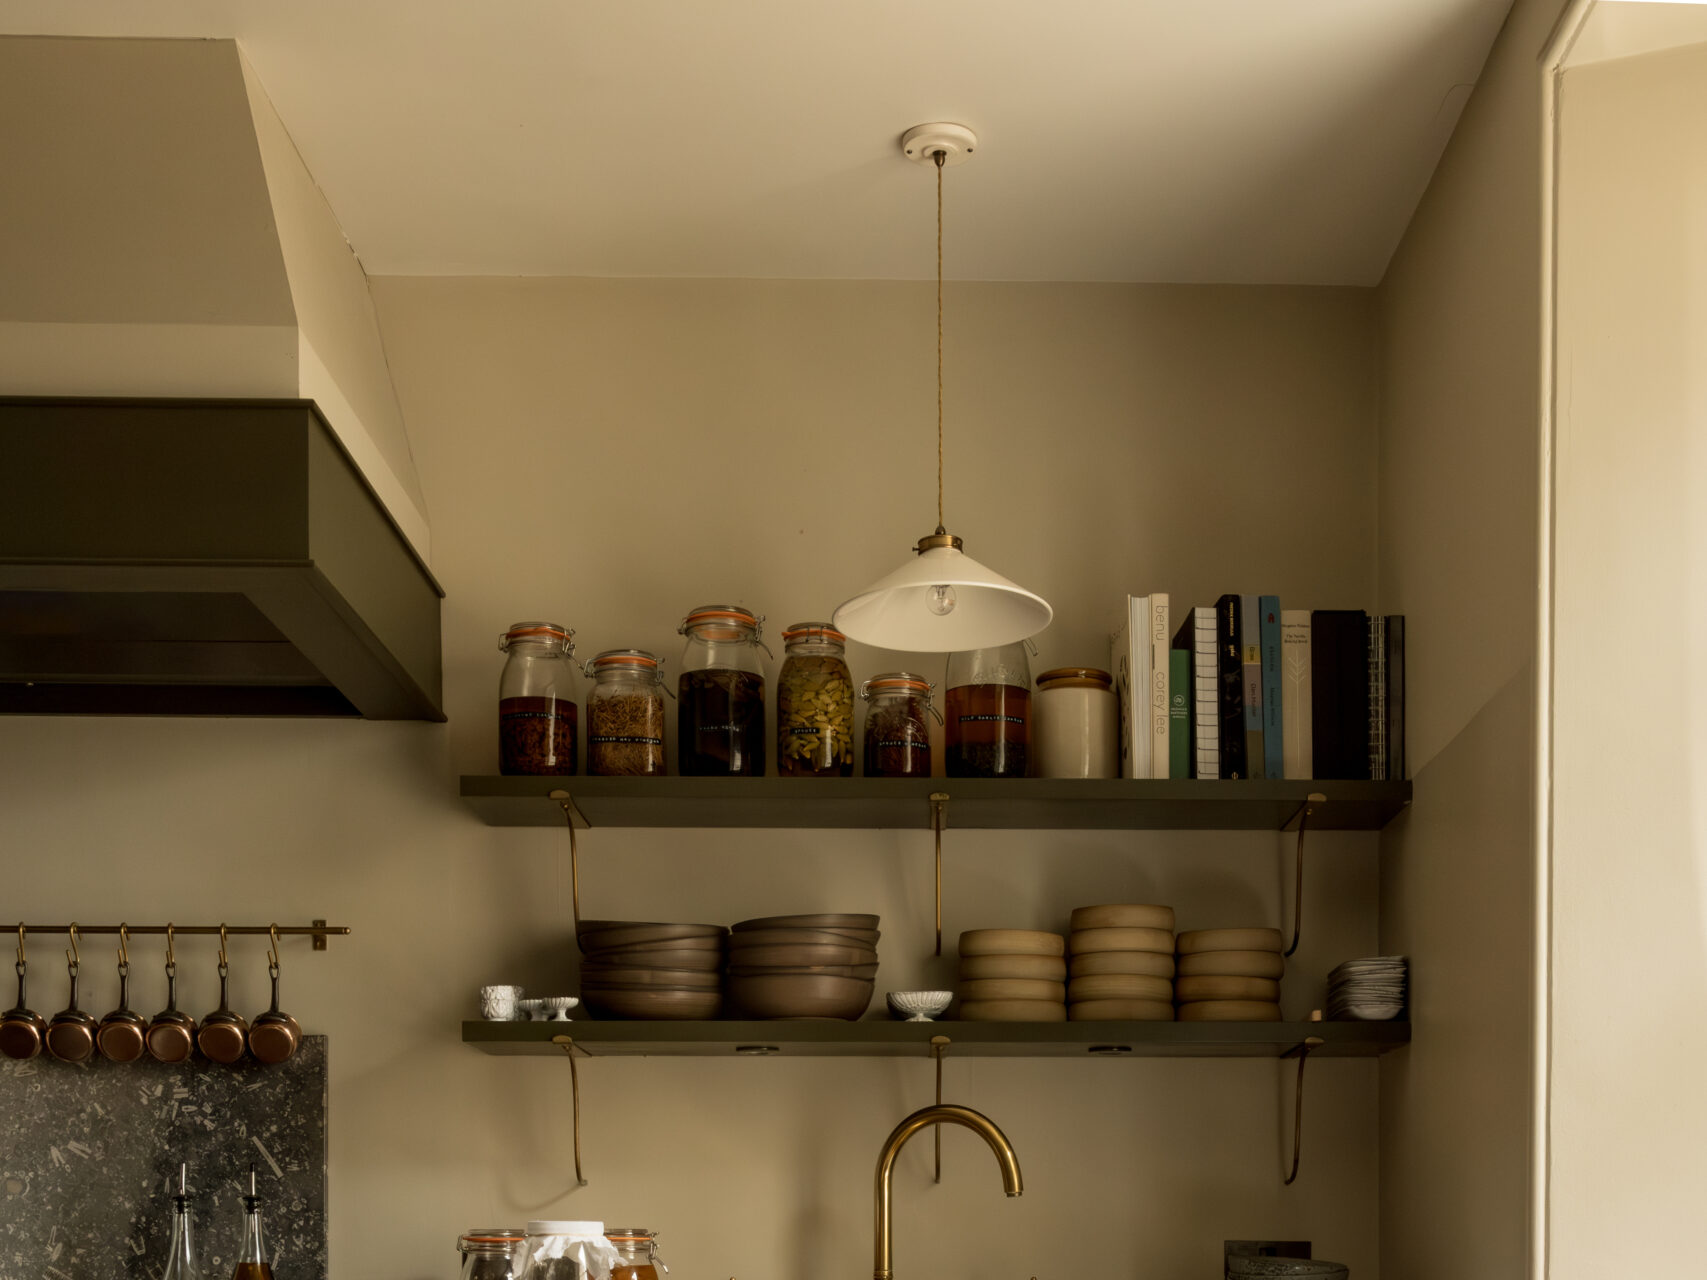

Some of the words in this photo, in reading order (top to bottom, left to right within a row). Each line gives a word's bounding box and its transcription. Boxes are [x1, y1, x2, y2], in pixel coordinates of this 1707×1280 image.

[1154, 605, 1169, 641] benu
[1152, 671, 1166, 711] corey
[1155, 715, 1169, 735] lee
